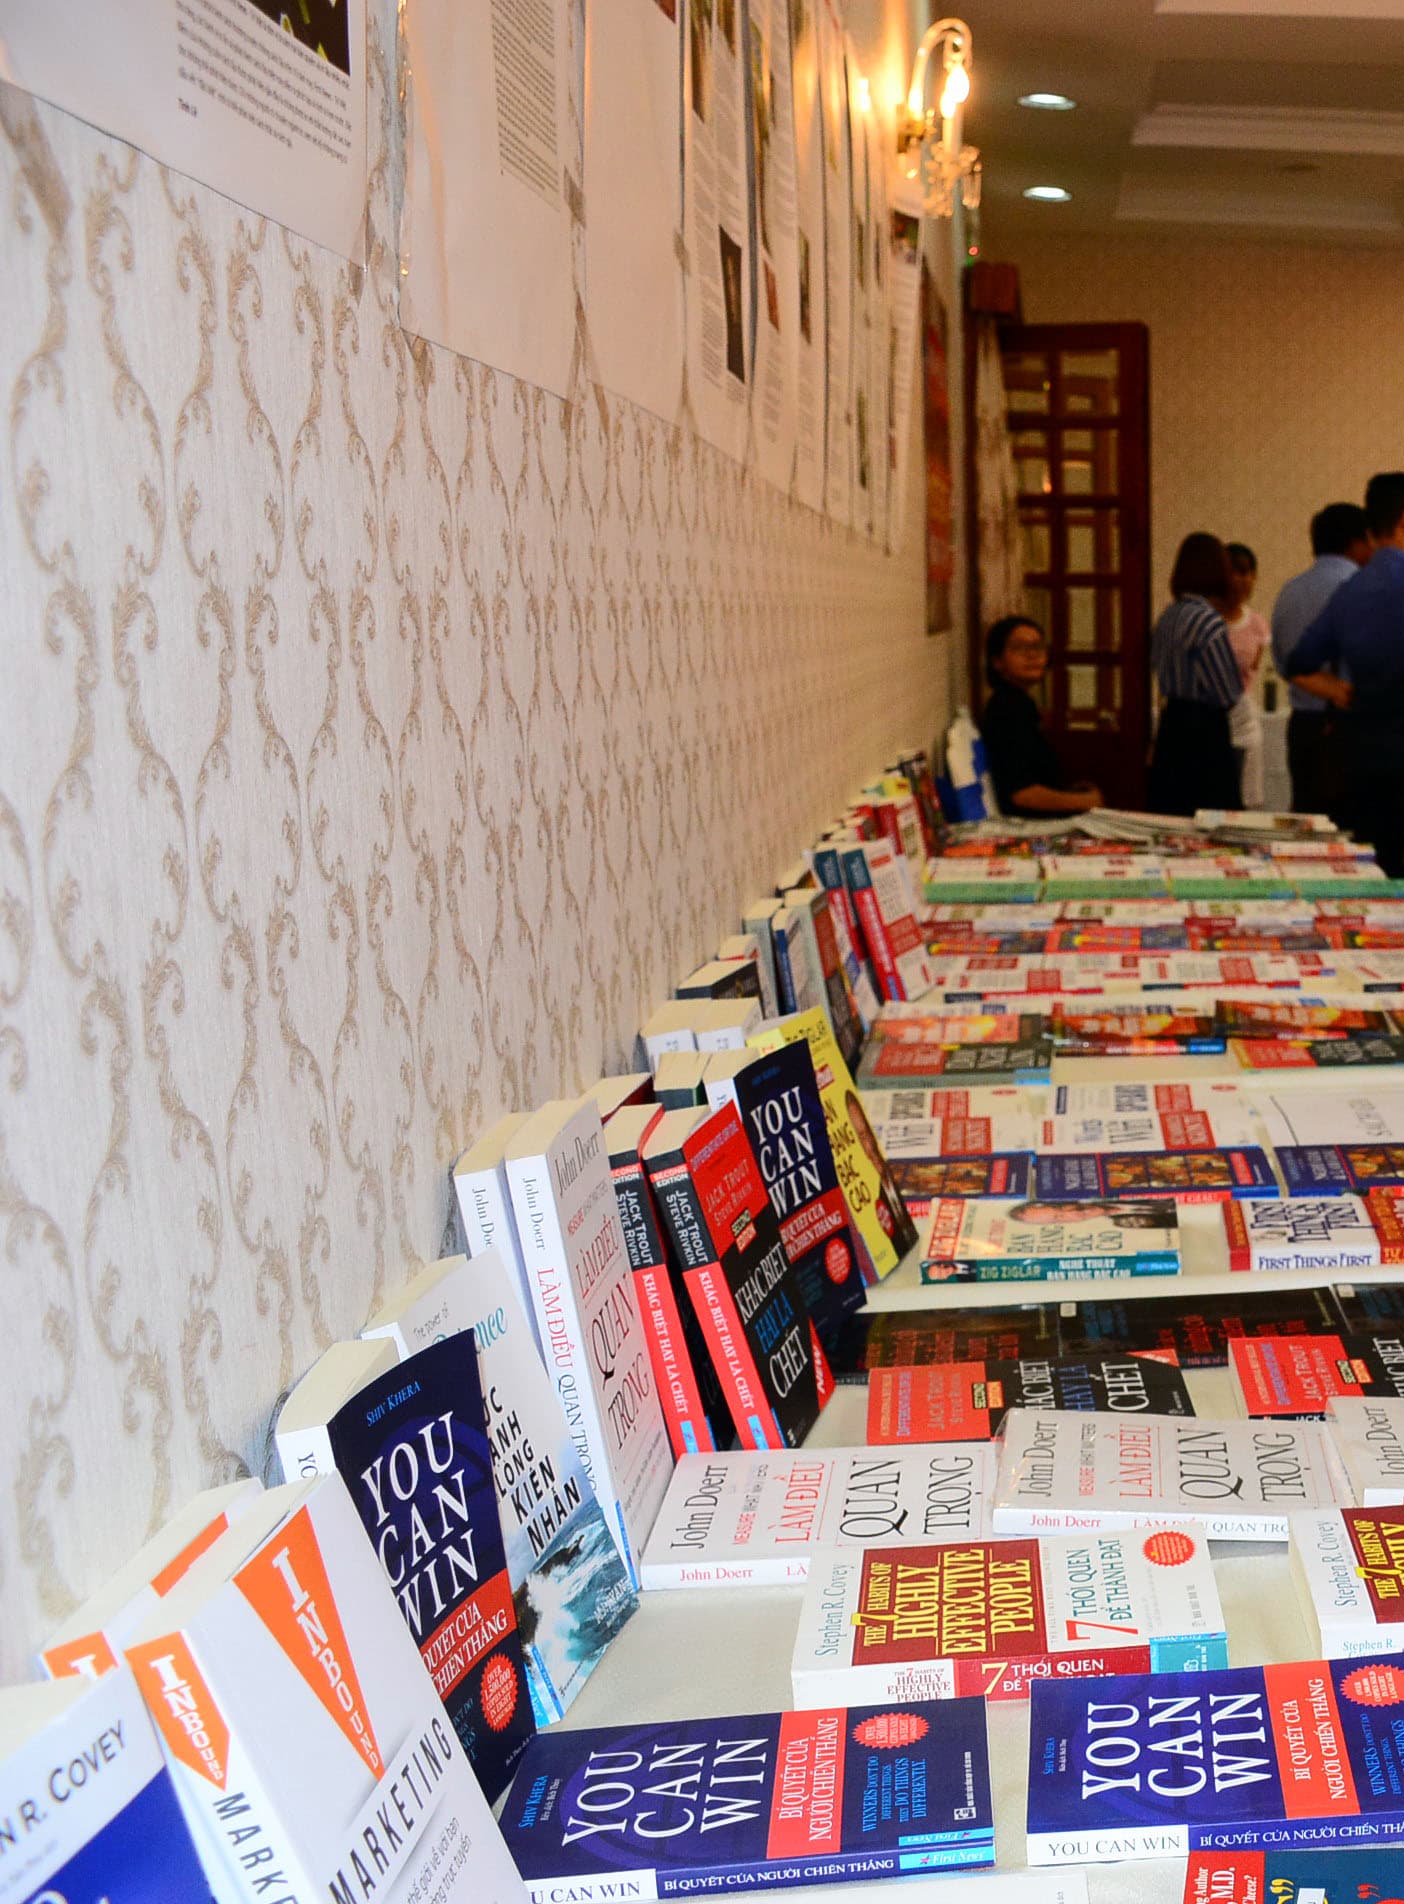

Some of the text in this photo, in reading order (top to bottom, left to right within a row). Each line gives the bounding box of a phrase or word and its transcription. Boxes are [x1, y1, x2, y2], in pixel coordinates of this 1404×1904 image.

[751, 1086, 803, 1144] YOU
[760, 1122, 814, 1183] CAN
[554, 1131, 599, 1198] John Doerr
[653, 1166, 687, 1181] SECOND
[655, 1173, 689, 1188] EDITION
[768, 1159, 822, 1219] WIN
[617, 1193, 641, 1267] STEVE RIVKIN
[625, 1189, 653, 1265] JACK TROUT
[666, 1194, 697, 1266] STEVE RIVKIN
[675, 1189, 709, 1264] JACK TROUT
[1258, 1252, 1373, 1271] FIRST THINGS FIRST
[980, 1263, 1042, 1279] ZIG ZIGLAR
[590, 1272, 637, 1389] QUAN
[607, 1352, 651, 1450] TRỌNG
[1363, 1405, 1398, 1442] Doerr
[361, 1410, 455, 1529] YOU
[922, 1455, 983, 1536] TRỌNG
[1018, 1420, 1060, 1498] John Doerr
[1177, 1427, 1244, 1501] QUAN
[1253, 1432, 1312, 1502] TRỌNG
[377, 1468, 470, 1589] CAN
[669, 1464, 729, 1550] John Doerr
[768, 1461, 826, 1543] LÀM ĐIỀU
[838, 1458, 910, 1540] QUAN
[1029, 1513, 1258, 1535] John Doerr QUAN
[396, 1528, 480, 1637] WIN
[989, 1559, 1035, 1635] PEOPLE
[1353, 1519, 1402, 1600] THE 7 HABITS OF
[851, 1561, 899, 1647] THE 7 HABITS OF
[893, 1565, 940, 1641] HIGHLY
[941, 1548, 987, 1655] EFFECTIVE
[1066, 1619, 1139, 1642] 7
[272, 1547, 380, 1770] INBOUND
[888, 1682, 951, 1695] EFFECTIVE
[896, 1673, 943, 1686] HIGHLY
[981, 1661, 1010, 1695] 7
[1056, 1658, 1105, 1674] QUEN
[149, 1653, 225, 1781] INBOUND
[1082, 1701, 1141, 1800] YOU
[1147, 1696, 1207, 1798] CAN
[1209, 1693, 1273, 1793] WIN
[1280, 1699, 1313, 1781] BÍ QUYẾT CỦA
[48, 1719, 127, 1804] COVEY
[561, 1750, 644, 1847] YOU
[633, 1742, 709, 1839] CAN
[700, 1738, 770, 1834] WIN
[328, 1717, 452, 1904] MARKETING
[1193, 1866, 1209, 1896] Author
[1210, 1866, 1236, 1899] M.D.
